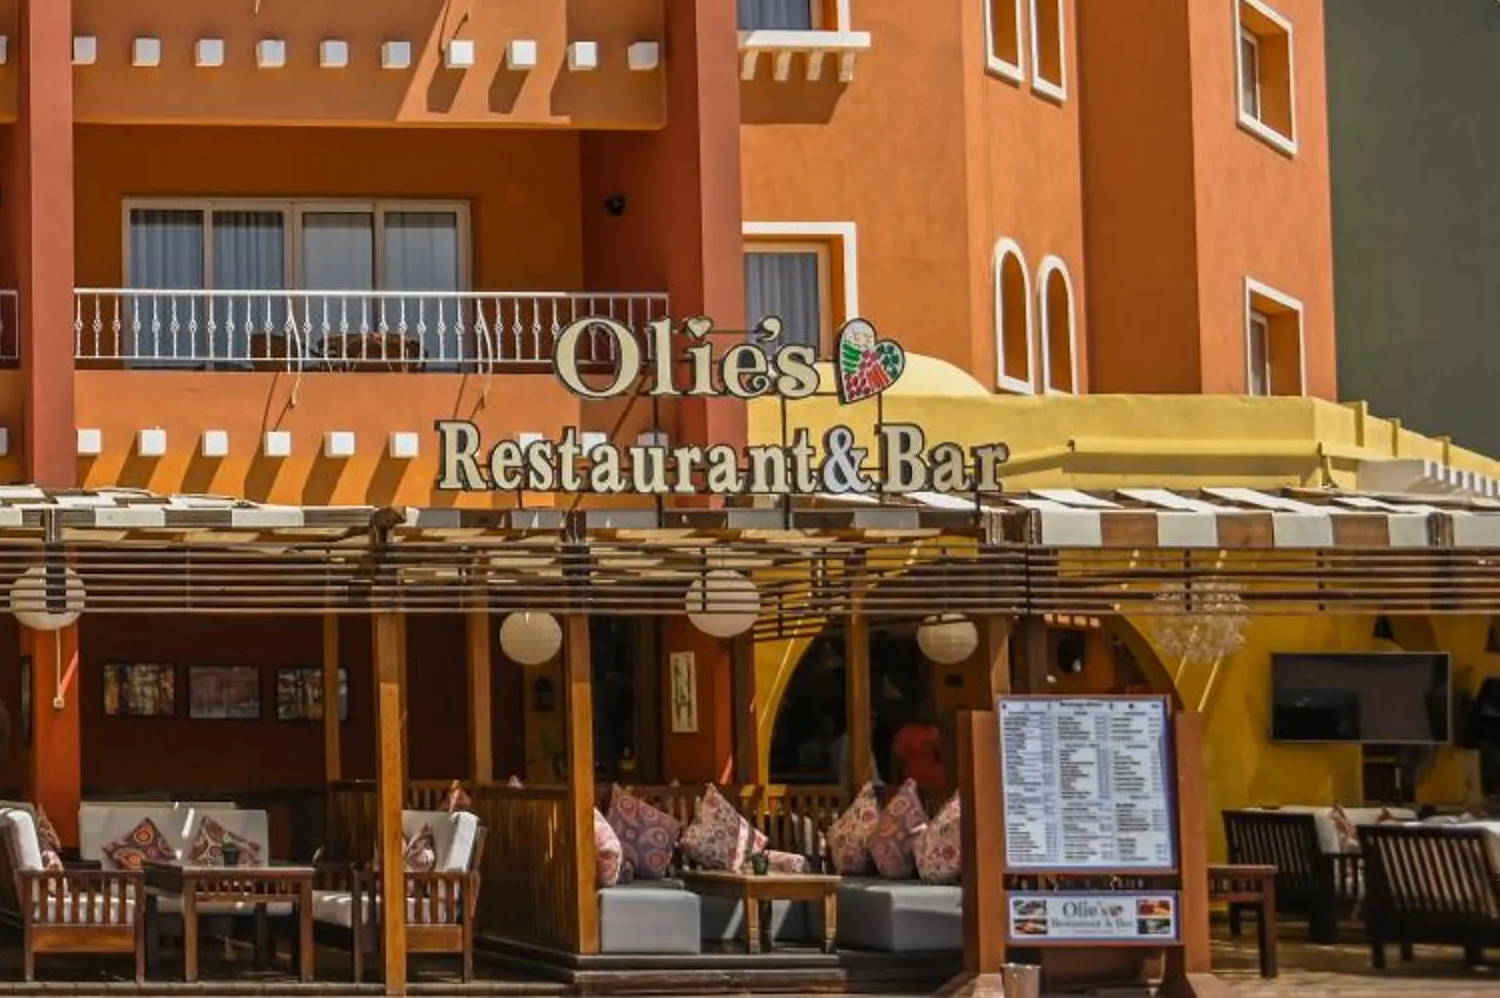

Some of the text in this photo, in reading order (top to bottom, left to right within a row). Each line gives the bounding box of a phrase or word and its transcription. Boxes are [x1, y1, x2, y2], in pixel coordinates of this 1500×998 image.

[554, 315, 821, 399] Olie's
[435, 420, 818, 493] Restaurant
[875, 422, 1010, 492] Bar
